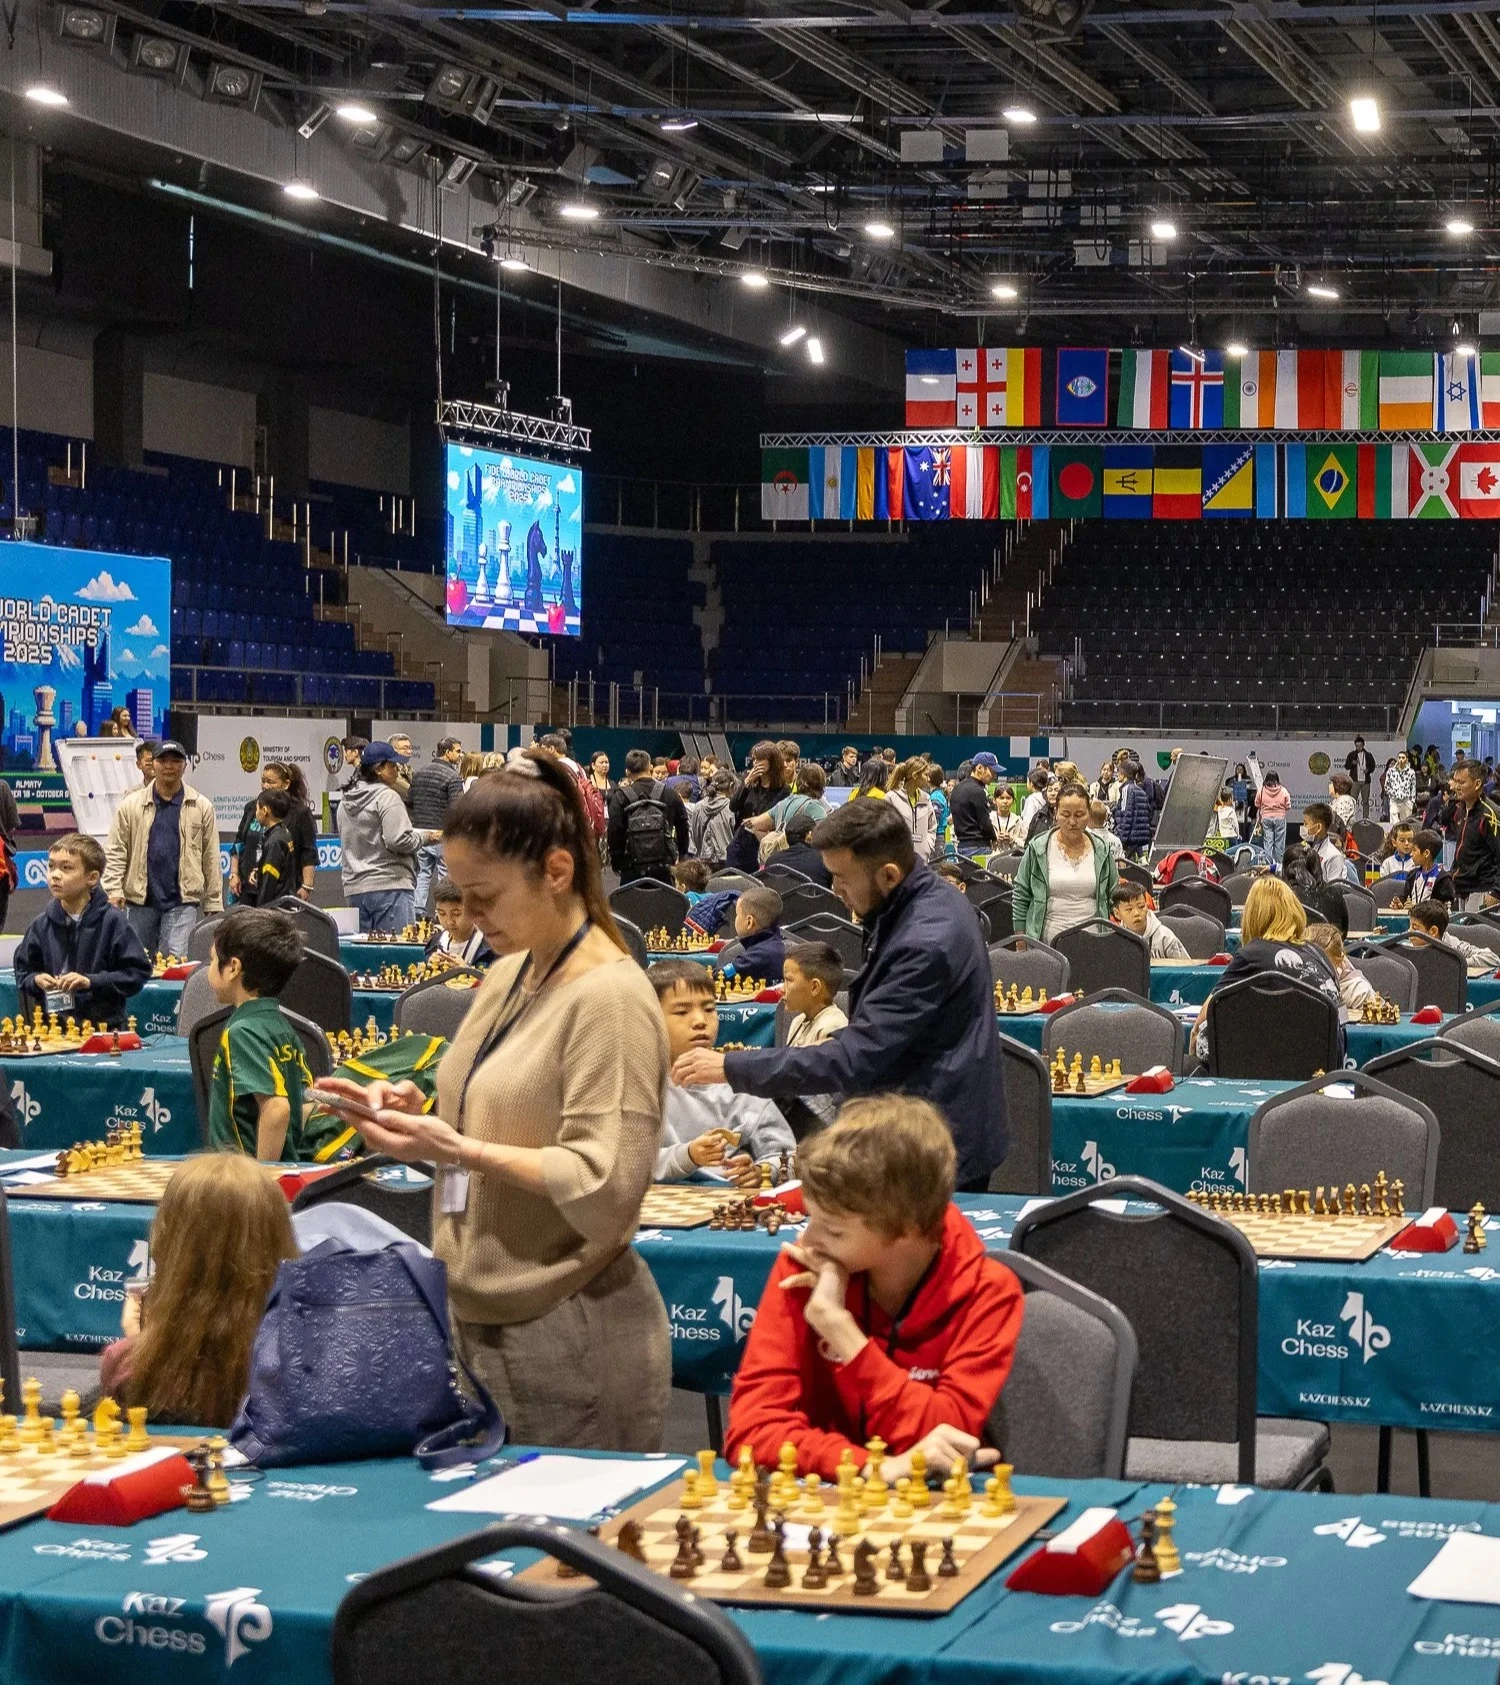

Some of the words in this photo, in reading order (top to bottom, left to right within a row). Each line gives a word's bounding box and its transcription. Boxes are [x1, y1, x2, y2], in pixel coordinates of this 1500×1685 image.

[57, 604, 112, 627] CADET
[3, 642, 53, 665] 2025
[203, 751, 225, 761] Chess
[263, 755, 282, 763] TOURISM
[16, 780, 42, 789] ALMATY
[36, 790, 64, 799] OCTOBER
[153, 1014, 171, 1022] Kaz
[718, 1013, 736, 1022] ess
[115, 1105, 137, 1116] Kaz
[1116, 1107, 1163, 1121] Chess
[1051, 1160, 1077, 1173] Kaz
[1202, 1167, 1224, 1180] Kaz
[1052, 1172, 1087, 1187] hess
[89, 1266, 123, 1282] Kaz
[671, 1304, 707, 1320] Kaz
[1297, 1319, 1335, 1337] Kaz
[1282, 1338, 1348, 1358] Chess
[1300, 1393, 1370, 1407] KAZCHESS.KZ
[1421, 1403, 1492, 1416] KAZCHESS.KZ
[122, 1592, 187, 1618] Kaz
[95, 1615, 206, 1655] Chess
